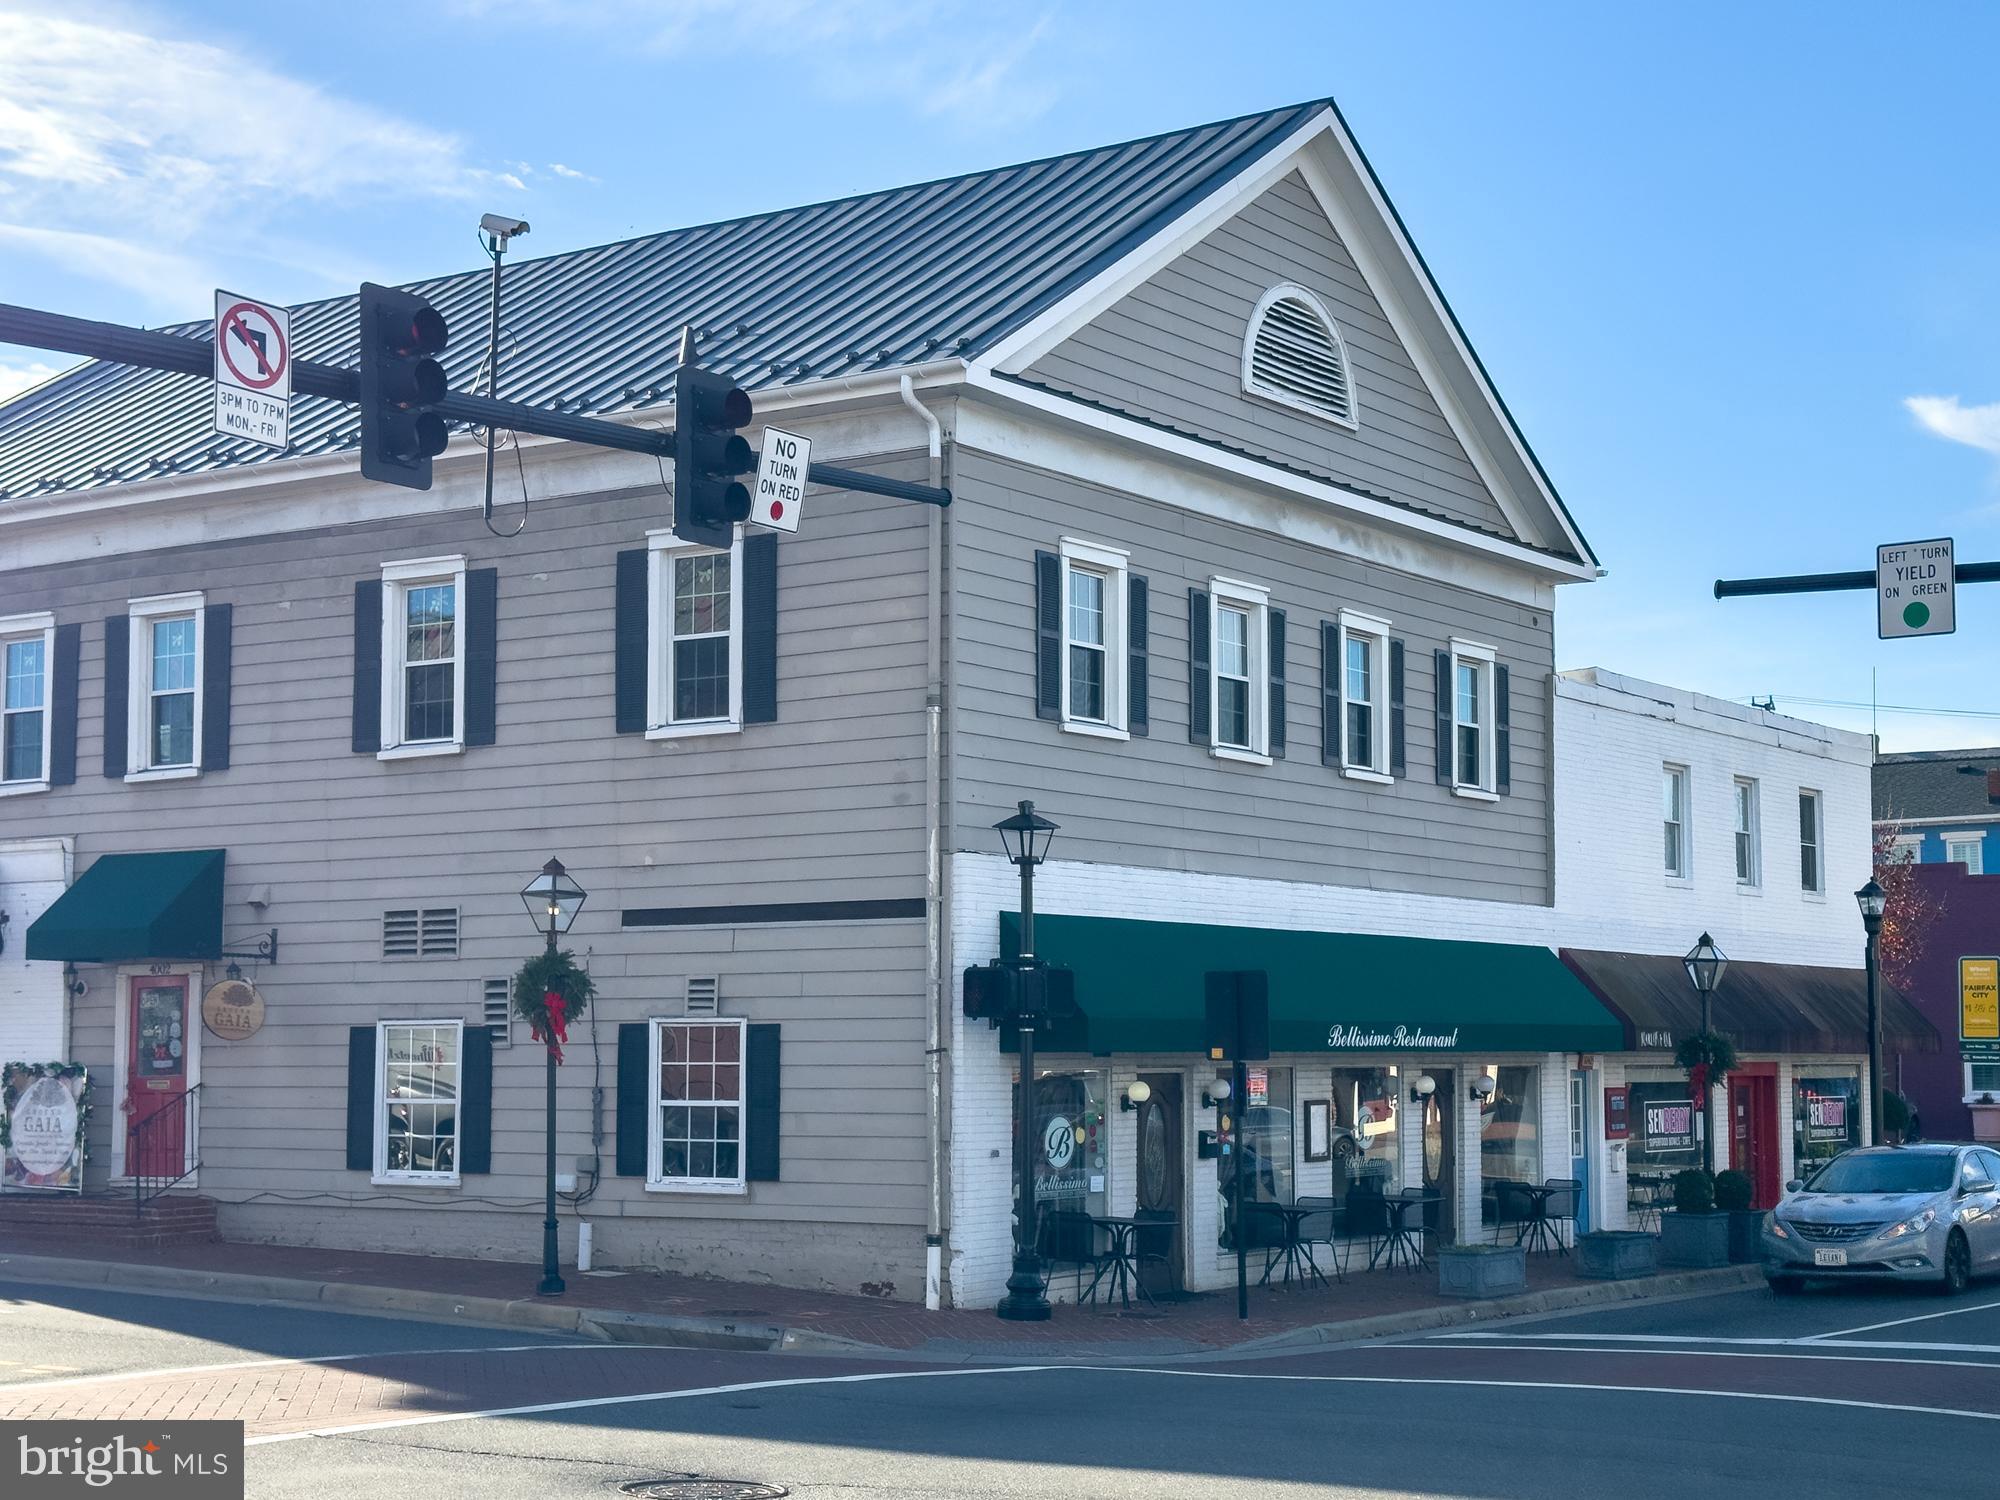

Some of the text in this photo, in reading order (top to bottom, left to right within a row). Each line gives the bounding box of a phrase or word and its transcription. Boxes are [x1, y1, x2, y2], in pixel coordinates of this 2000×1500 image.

[220, 391, 284, 421] 3PM TO 7PM
[260, 422, 277, 438] FRI
[775, 437, 797, 460] NO
[769, 459, 798, 481] TURN
[760, 479, 800, 502] ON RED
[1882, 546, 1949, 564] LEFT TURN
[1895, 564, 1937, 582] YIELD
[1885, 582, 1948, 599] ON GREEN
[149, 963, 171, 976] 4002
[1964, 984, 1997, 992] FAIRFAX
[214, 1013, 252, 1029] GAIA
[1327, 1023, 1459, 1048] Bellissimo Restaurant
[23, 1116, 64, 1133] GAIA
[1046, 1125, 1072, 1160] B
[1034, 1175, 1088, 1191] Bellissimo
